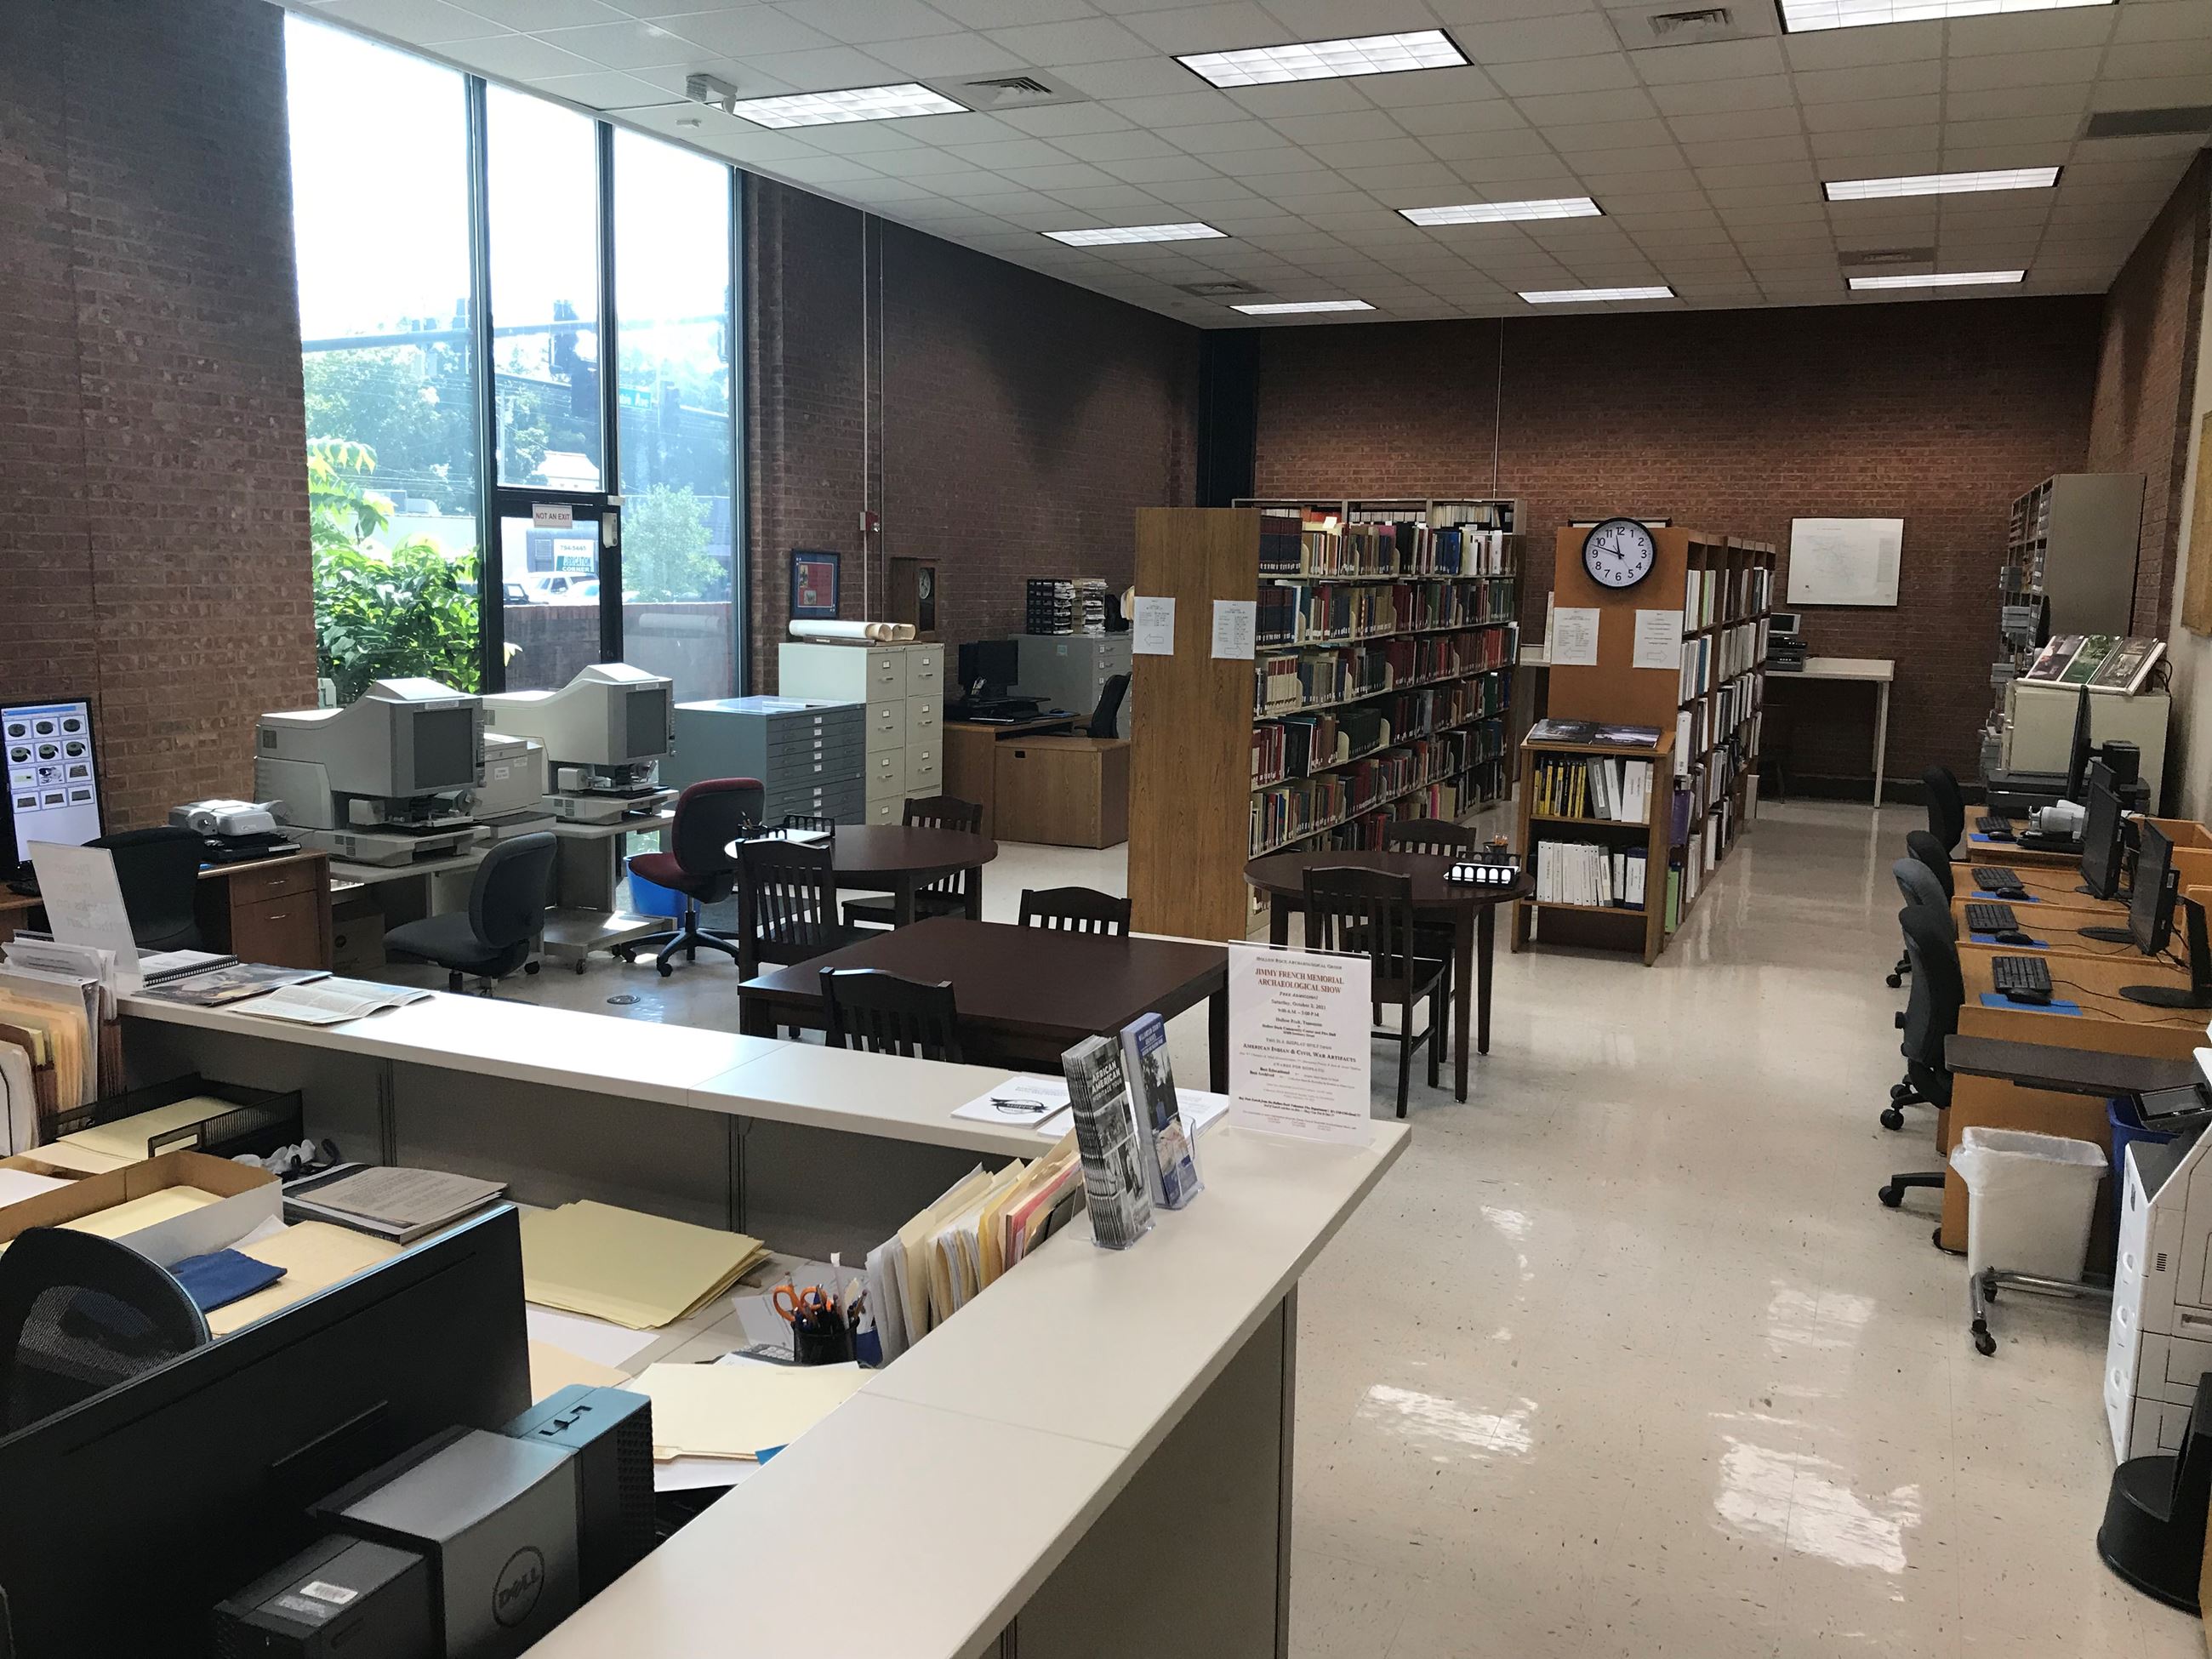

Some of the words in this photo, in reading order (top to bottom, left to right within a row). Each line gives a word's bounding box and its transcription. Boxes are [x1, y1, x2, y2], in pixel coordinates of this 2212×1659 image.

[1616, 527, 1625, 535] 12
[1597, 538, 1605, 546] 10
[1638, 538, 1644, 546] 2
[1592, 550, 1598, 558] 9
[1641, 550, 1647, 558] 3
[1595, 562, 1601, 570] 8
[1616, 573, 1621, 581] 6
[1628, 569, 1633, 578] 5
[1255, 968, 1277, 977] JIMMY
[1279, 971, 1305, 979] FRENCH
[1307, 973, 1344, 984] MEMORIAL
[1258, 978, 1320, 992] ARCHAEOLOGICAL
[1320, 985, 1342, 994] SHOW
[1243, 1043, 1270, 1052] AMERICAN
[1327, 1053, 1356, 1063] ARTIFACTS
[1092, 1060, 1117, 1082] AFRICAN
[1092, 1068, 1121, 1095] AMERICAN
[498, 1566, 540, 1608] DELL
